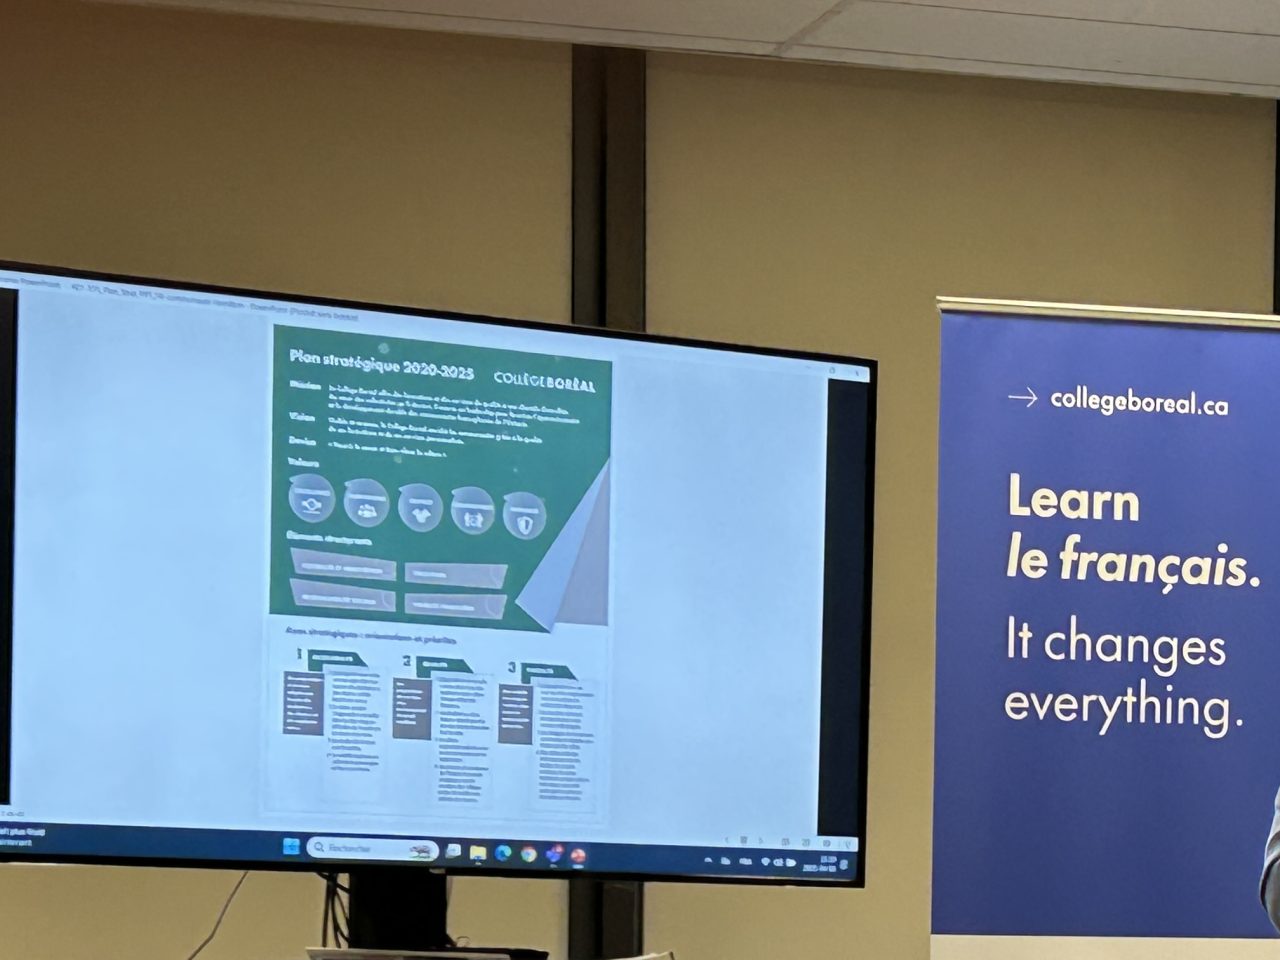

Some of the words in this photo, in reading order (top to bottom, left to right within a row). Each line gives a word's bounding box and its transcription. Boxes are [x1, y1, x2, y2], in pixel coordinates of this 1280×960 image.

[290, 349, 321, 364] Plan
[323, 354, 401, 374] stratégique
[403, 361, 475, 381] 2020-2025
[1050, 385, 1229, 416] collegeboreal.ca
[1009, 472, 1140, 522] Learn
[1006, 532, 1048, 579] le
[1059, 534, 1261, 594] français.
[1007, 615, 1033, 659] It
[1044, 614, 1227, 678] changes
[1004, 678, 1244, 739] everything.
